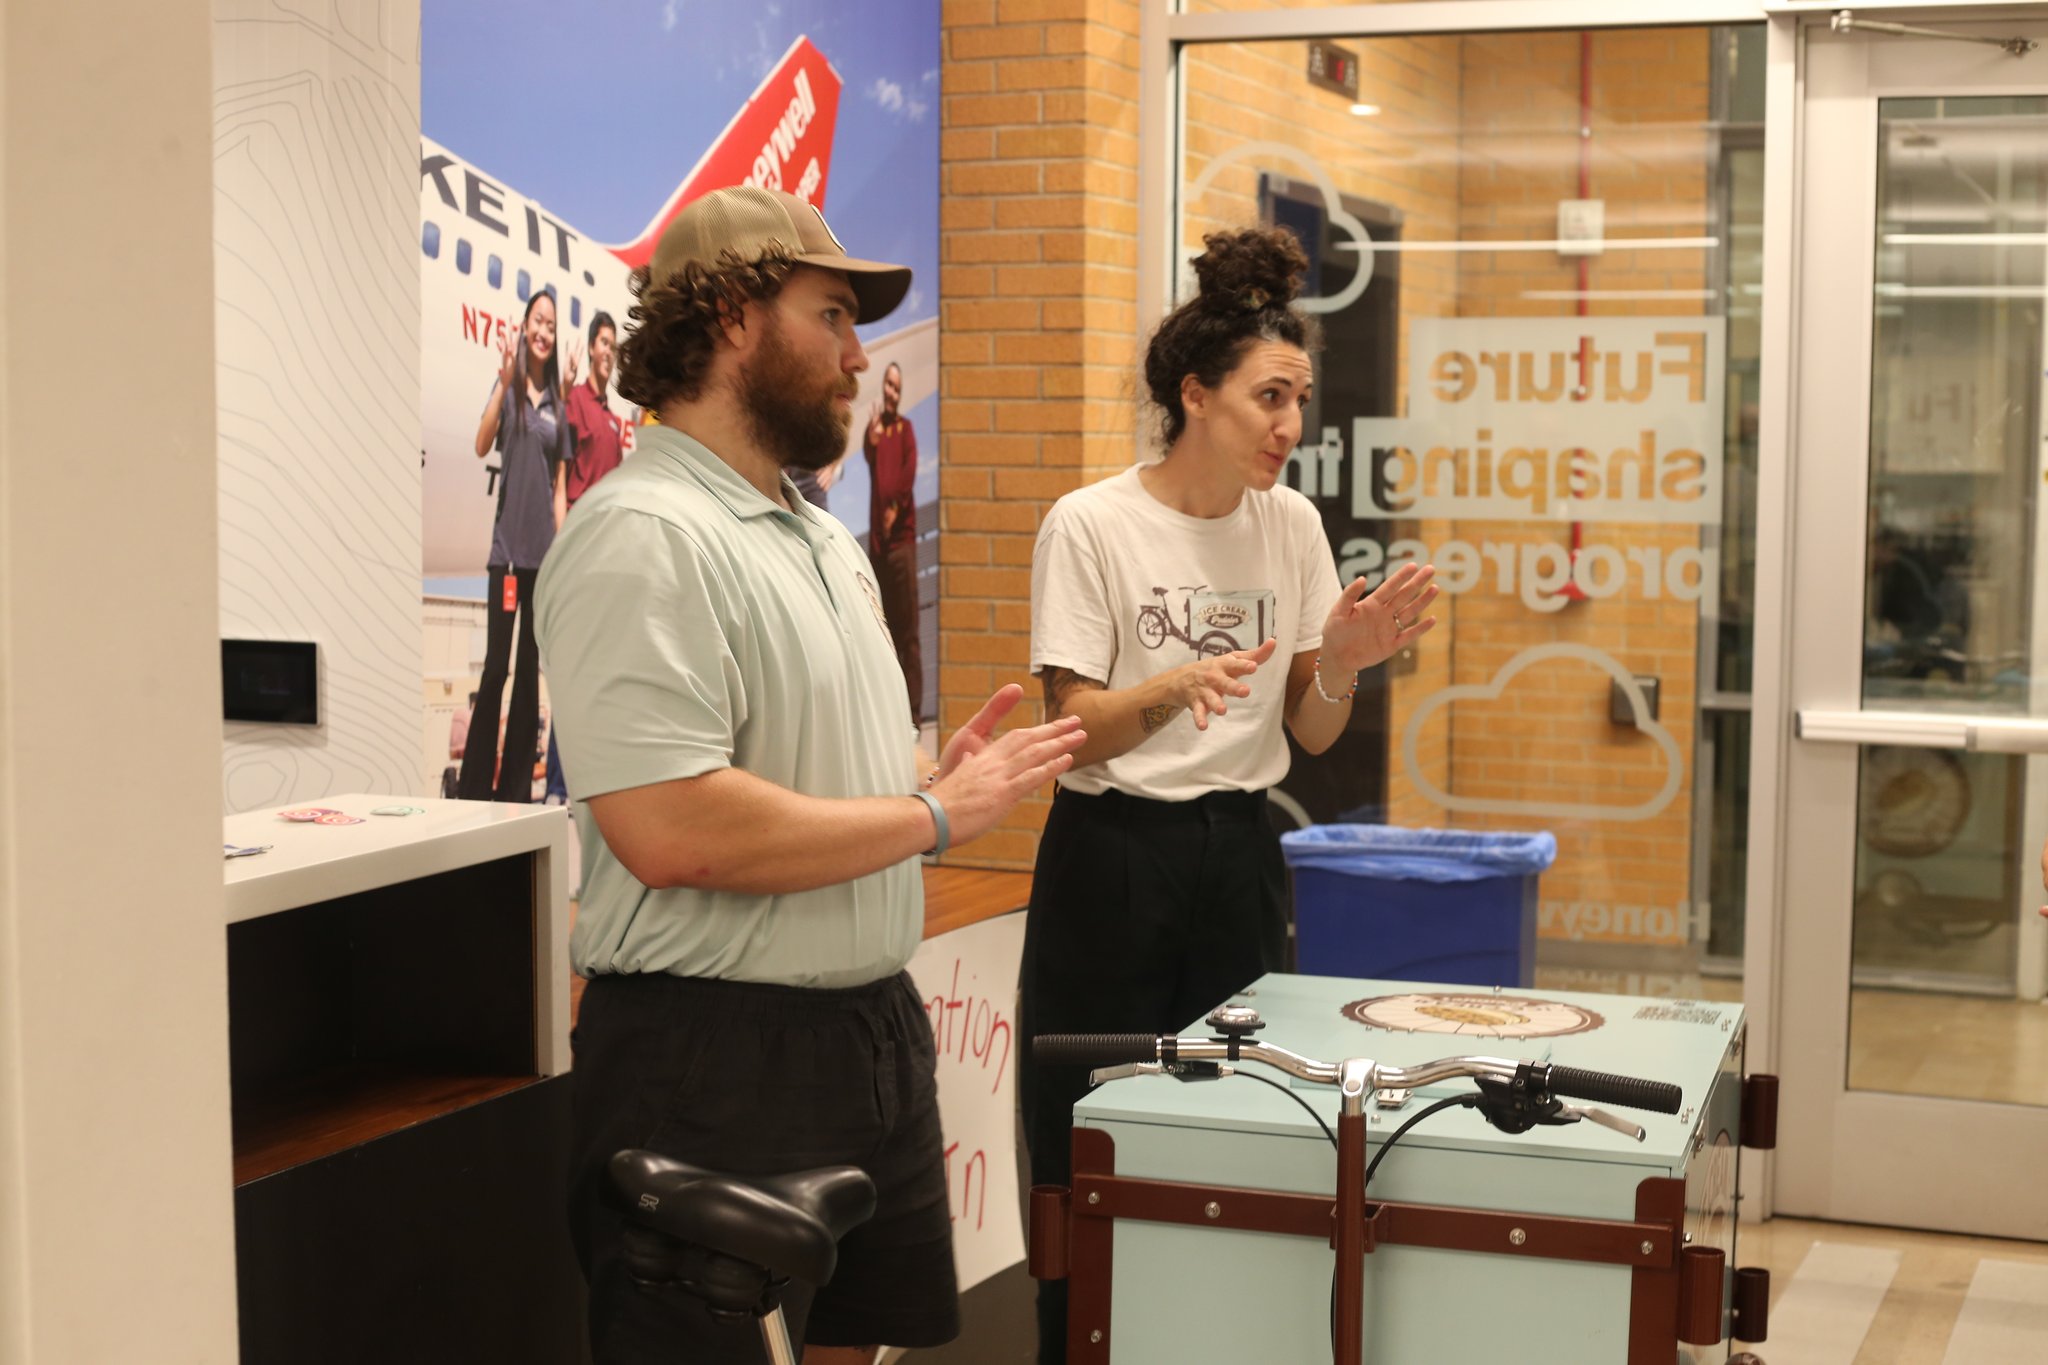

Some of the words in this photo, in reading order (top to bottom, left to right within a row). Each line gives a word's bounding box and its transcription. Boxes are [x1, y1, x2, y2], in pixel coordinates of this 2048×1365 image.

[525, 205, 596, 287] IT.
[1203, 606, 1218, 616] ICE
[1220, 605, 1247, 616] CREAM
